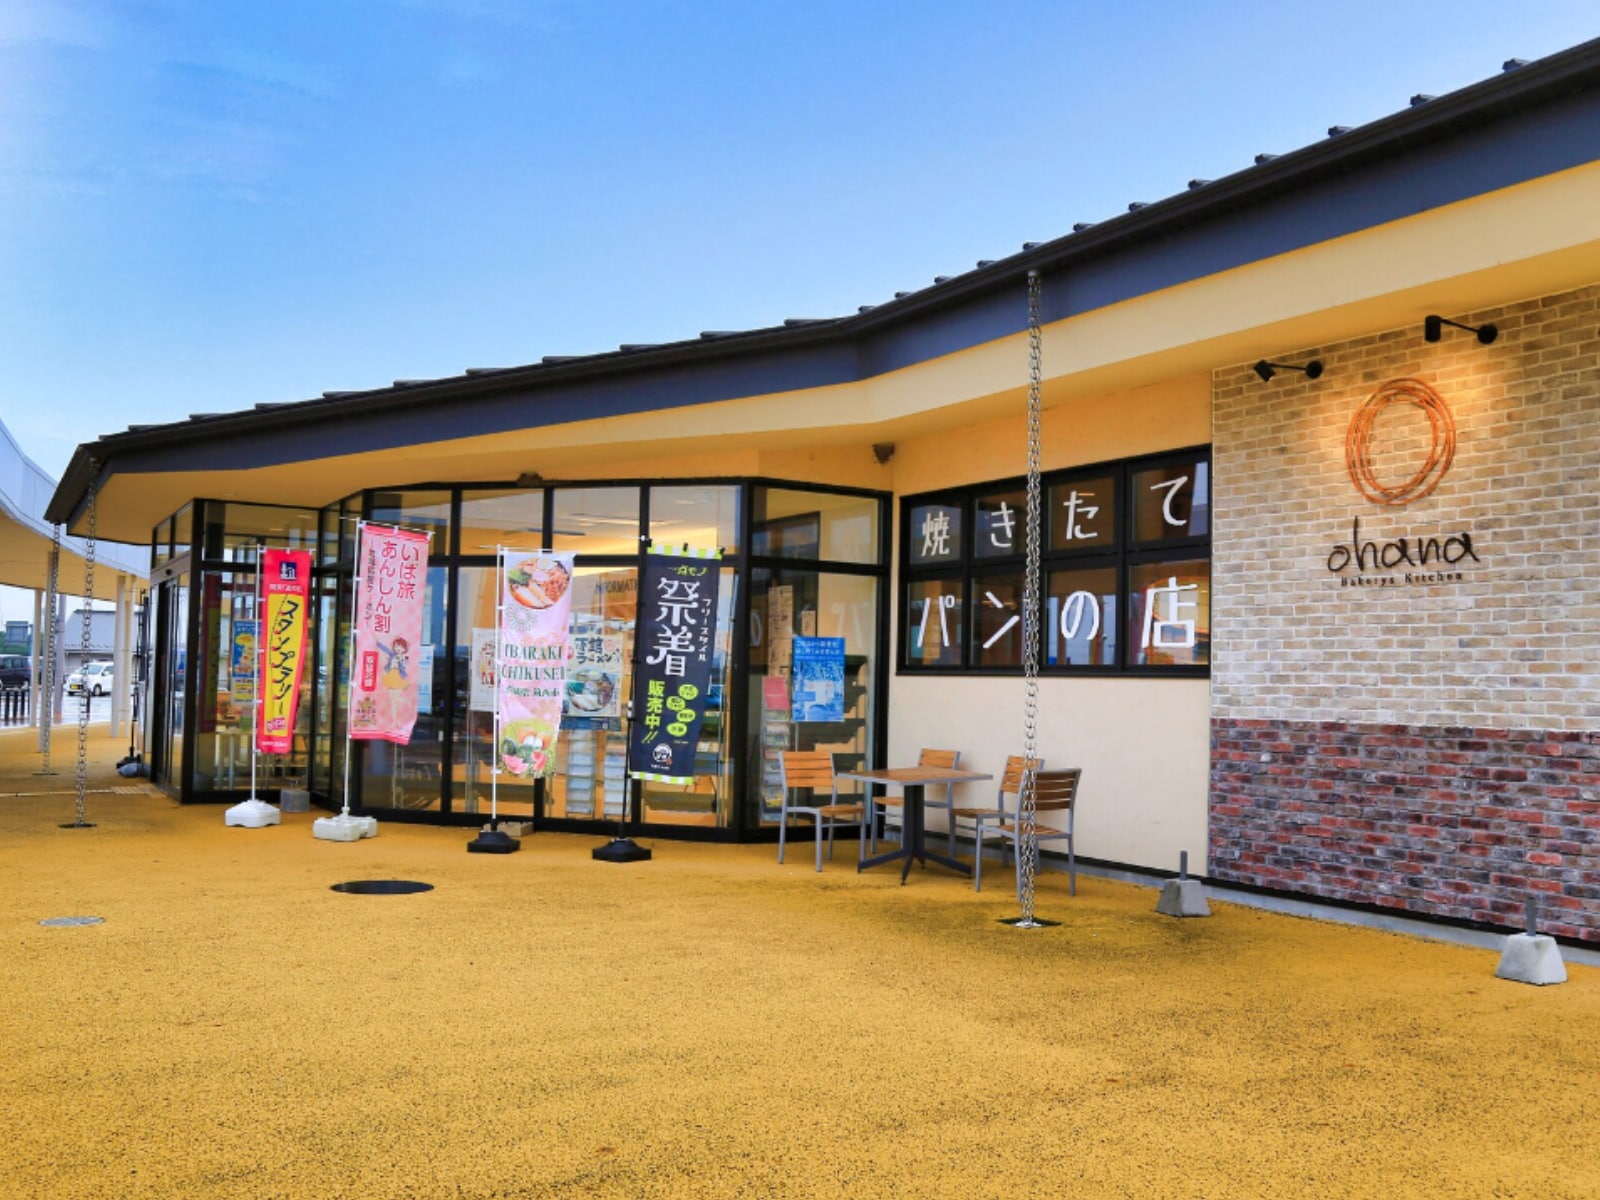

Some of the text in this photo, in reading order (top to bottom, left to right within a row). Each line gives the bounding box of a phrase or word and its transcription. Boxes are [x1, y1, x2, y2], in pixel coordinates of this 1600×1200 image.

[921, 475, 1189, 557] 焼きたて
[1327, 515, 1480, 573] ohana
[374, 540, 398, 634] あんしん割
[396, 544, 419, 600] いば旅
[1404, 571, 1463, 584] Kitchen
[698, 598, 713, 662] フリースタイル
[916, 576, 1200, 650] パンの店
[270, 600, 300, 715] スタンプラリー
[501, 664, 565, 681] CHIKUSEI
[504, 643, 563, 660] IBARAKI
